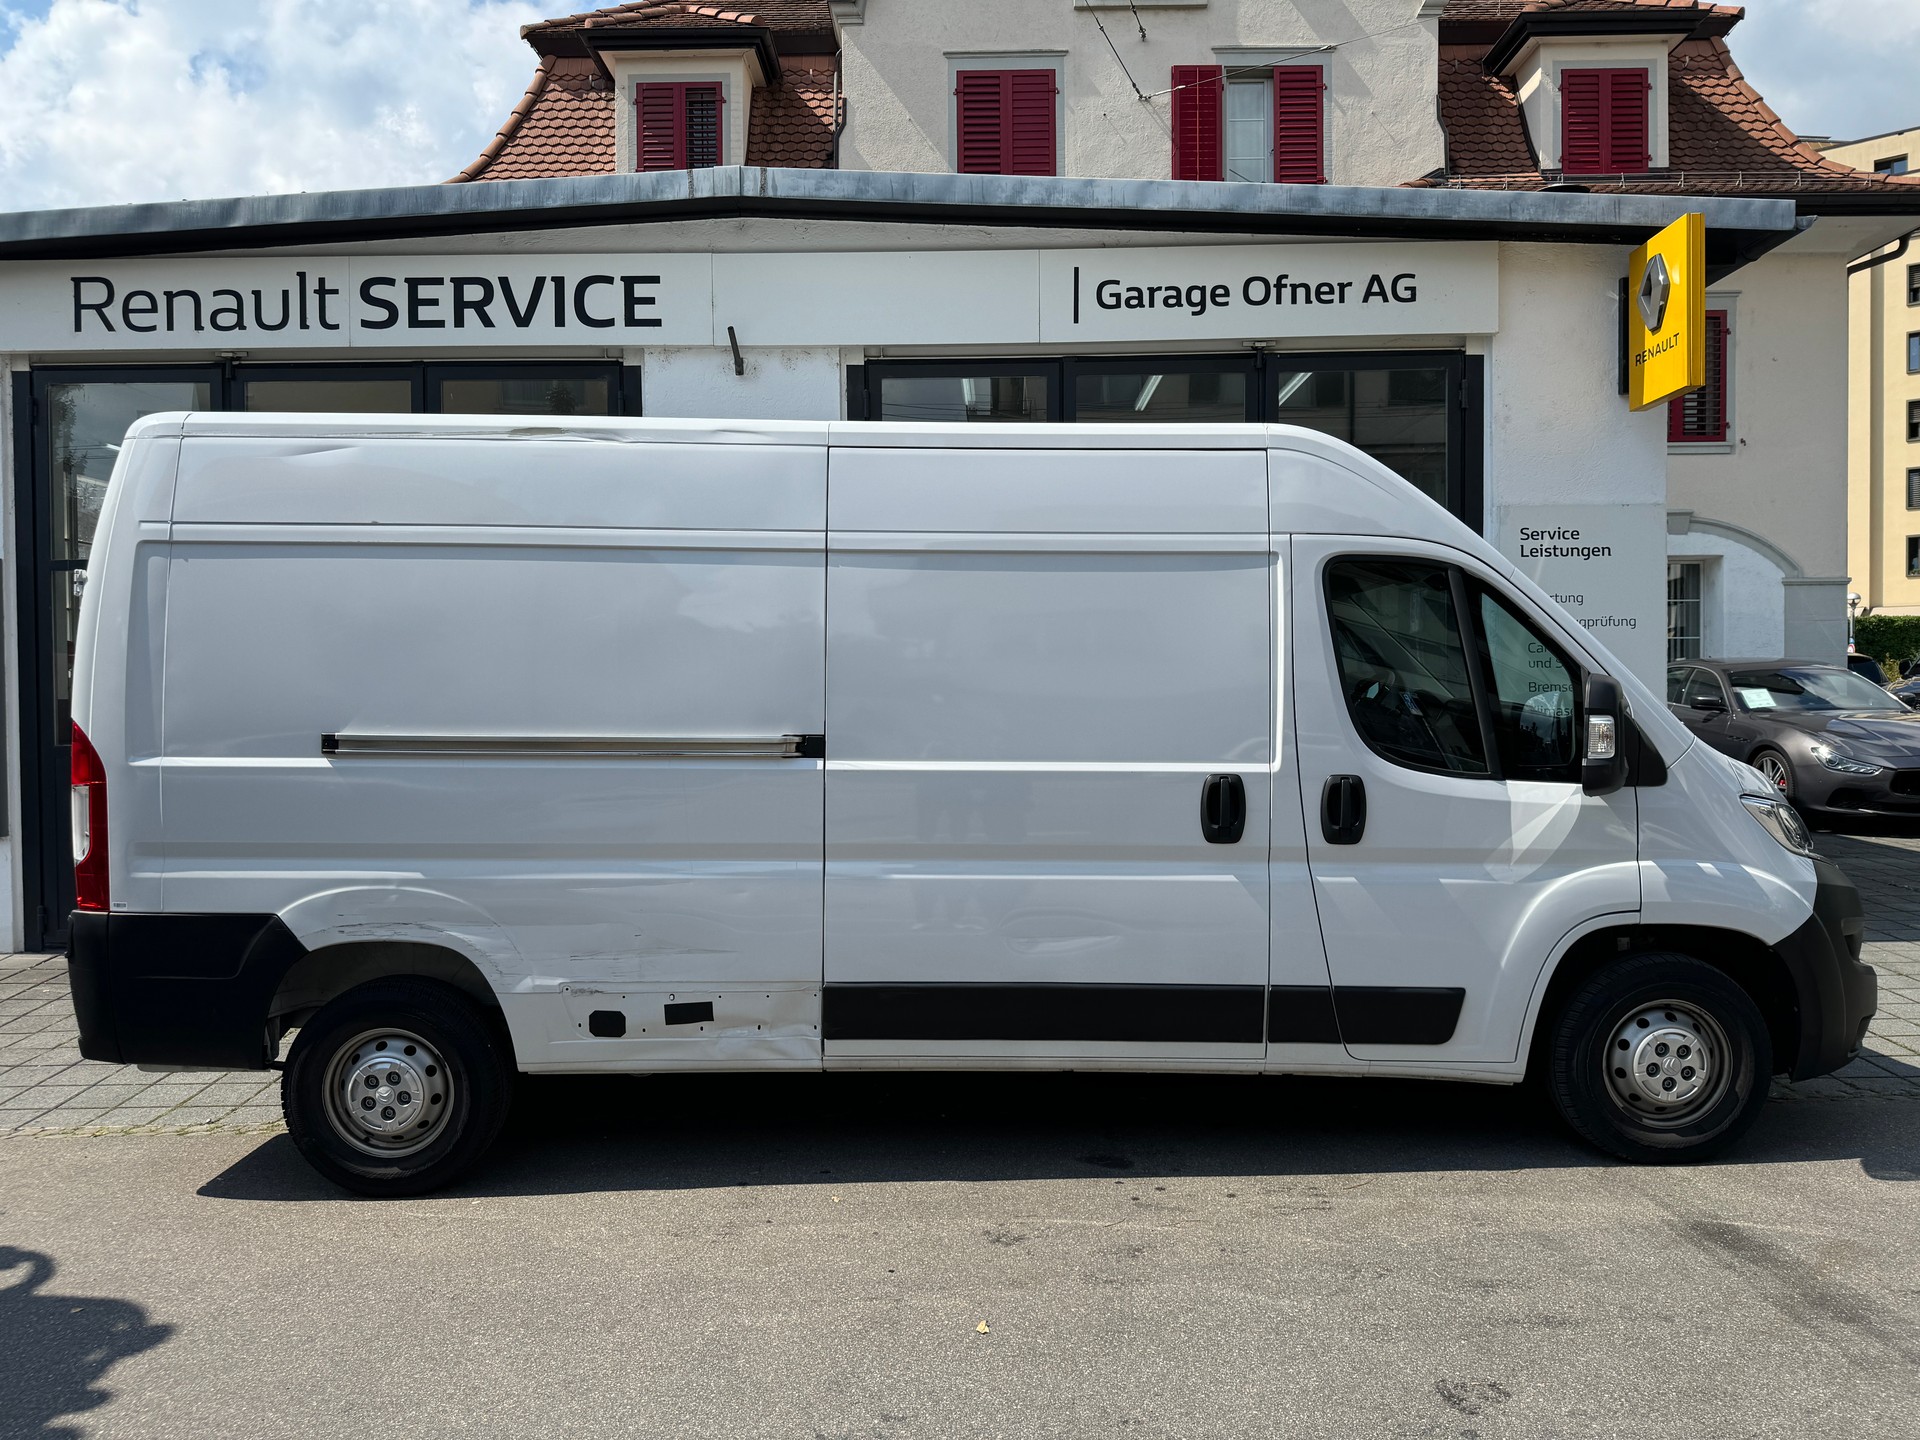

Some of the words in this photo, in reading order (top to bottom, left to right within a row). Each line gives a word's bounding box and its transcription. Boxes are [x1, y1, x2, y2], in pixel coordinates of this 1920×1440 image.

[71, 271, 340, 333] Renault
[359, 274, 663, 330] SERVICE
[1095, 279, 1231, 317] Garage
[1242, 275, 1353, 307] Ofner
[1361, 273, 1418, 304] AG
[1634, 332, 1681, 367] RENAULT
[1519, 526, 1581, 541] Service
[1519, 543, 1612, 561] Leistungen
[1576, 615, 1637, 630] gprüfung
[1528, 656, 1552, 669] und
